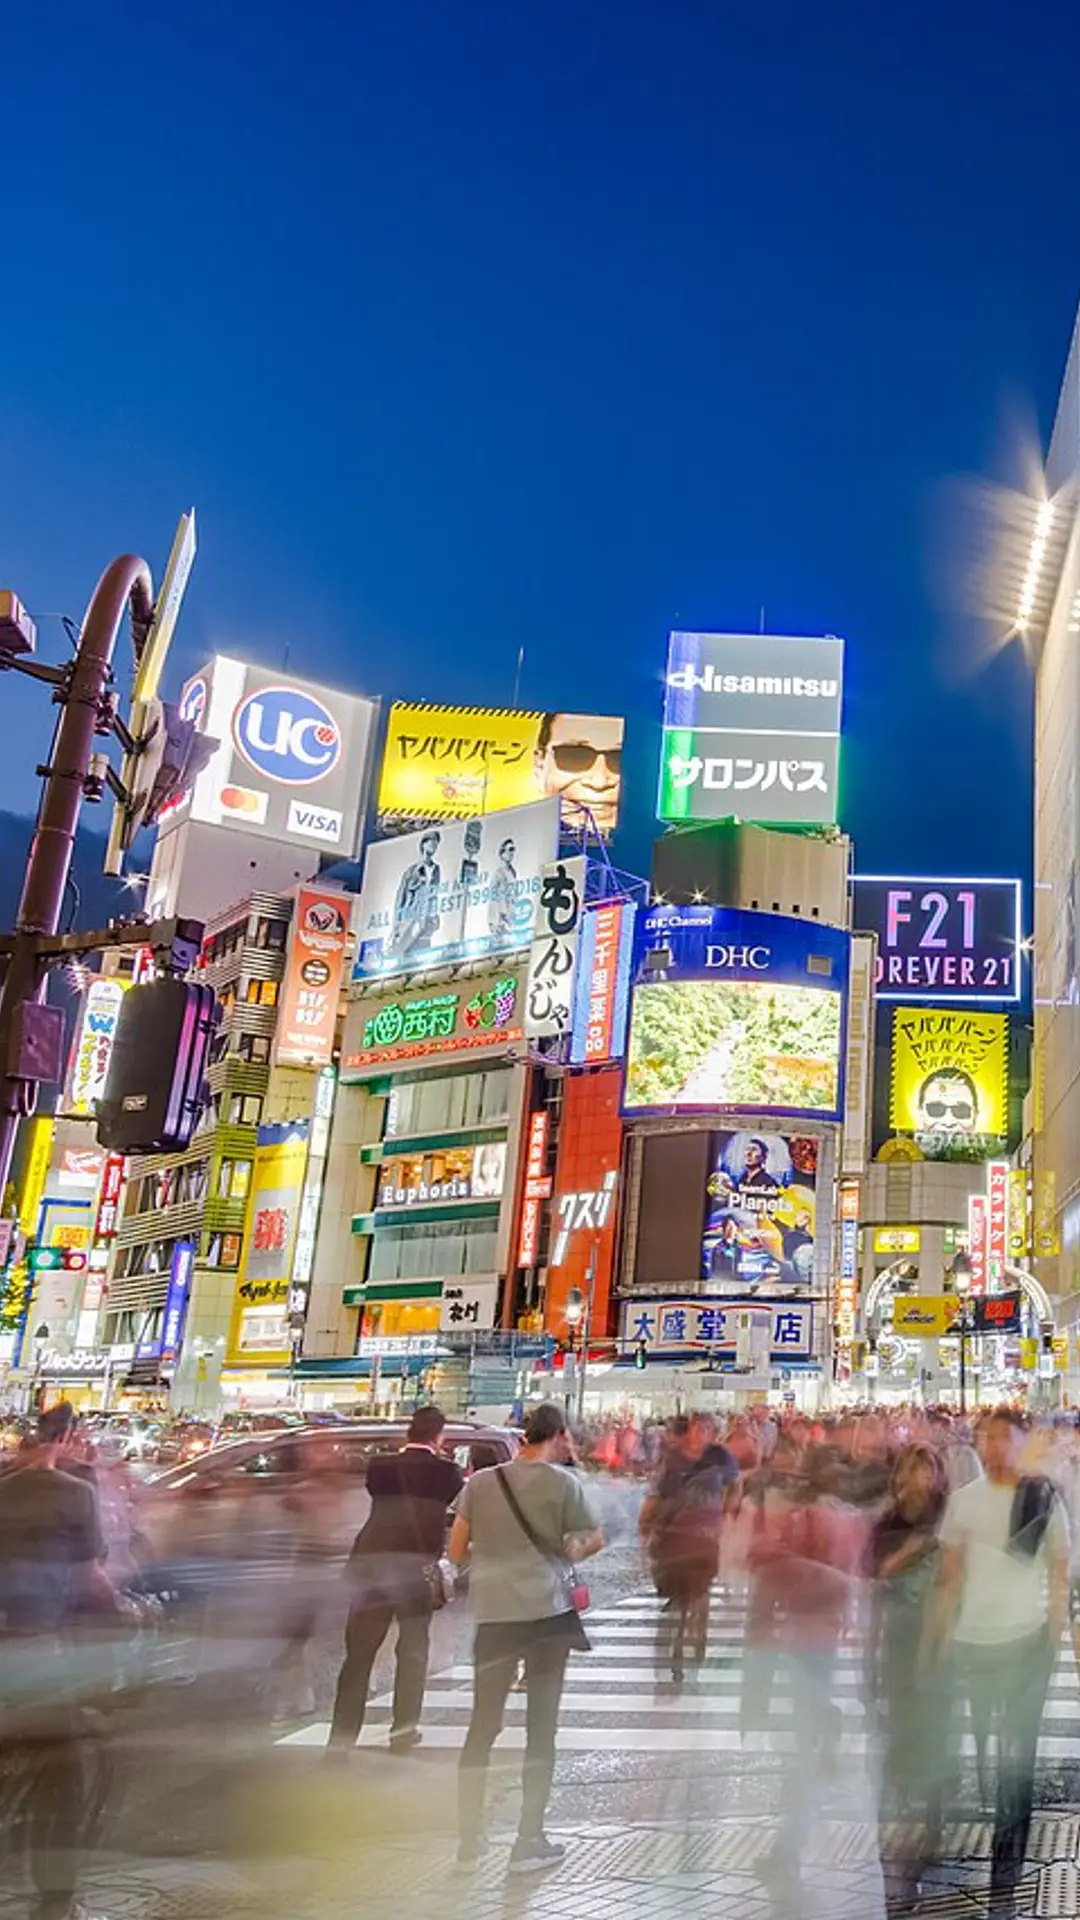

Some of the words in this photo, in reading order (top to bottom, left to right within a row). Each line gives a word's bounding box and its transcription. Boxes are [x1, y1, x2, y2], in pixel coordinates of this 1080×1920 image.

[245, 703, 332, 765] UC
[669, 756, 828, 792] サロンパス
[294, 810, 339, 834] VISA
[886, 890, 976, 949] F21
[528, 864, 580, 1029] もんじゃ
[704, 944, 771, 969] DHC
[586, 911, 615, 1052] 三千里薬品
[874, 957, 976, 985] OREVER
[983, 958, 1010, 985] 21
[632, 1310, 803, 1344] 大盛堂店
